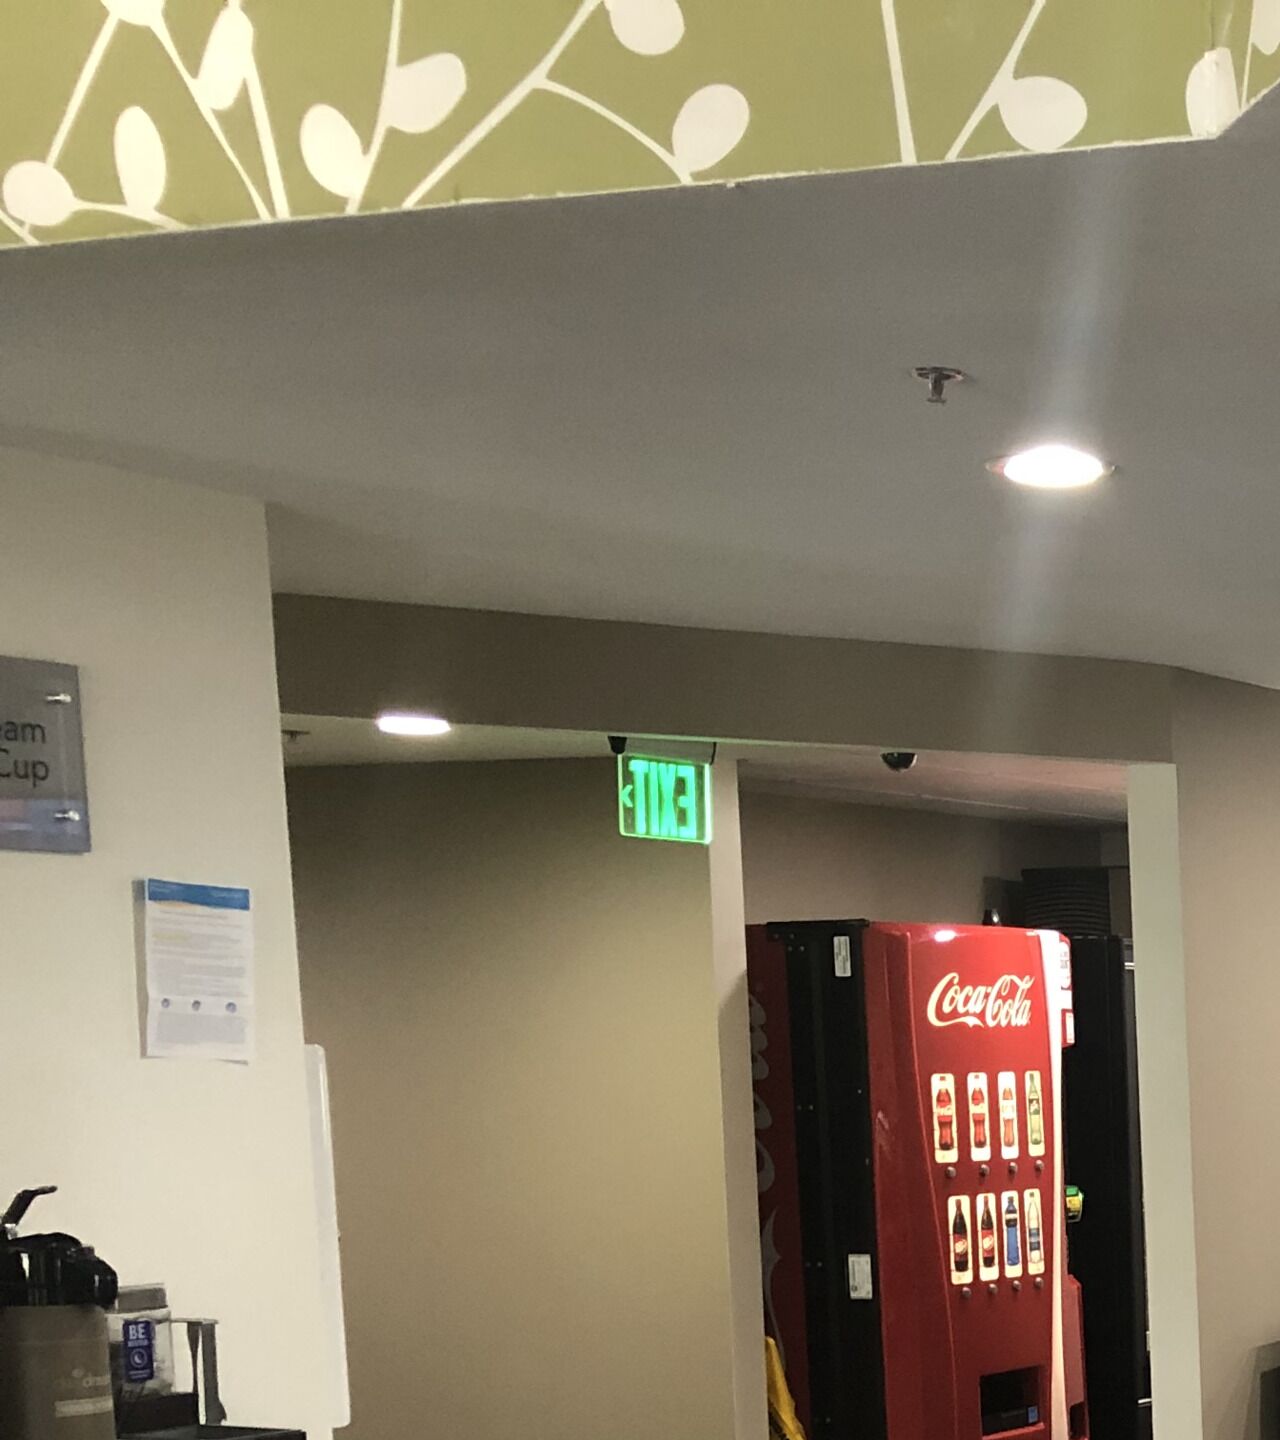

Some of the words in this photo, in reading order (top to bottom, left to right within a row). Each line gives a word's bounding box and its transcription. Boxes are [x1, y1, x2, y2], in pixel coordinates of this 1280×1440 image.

[0, 721, 47, 744] am
[927, 972, 1035, 1028] Coca-Cola
[128, 1323, 146, 1339] BE
